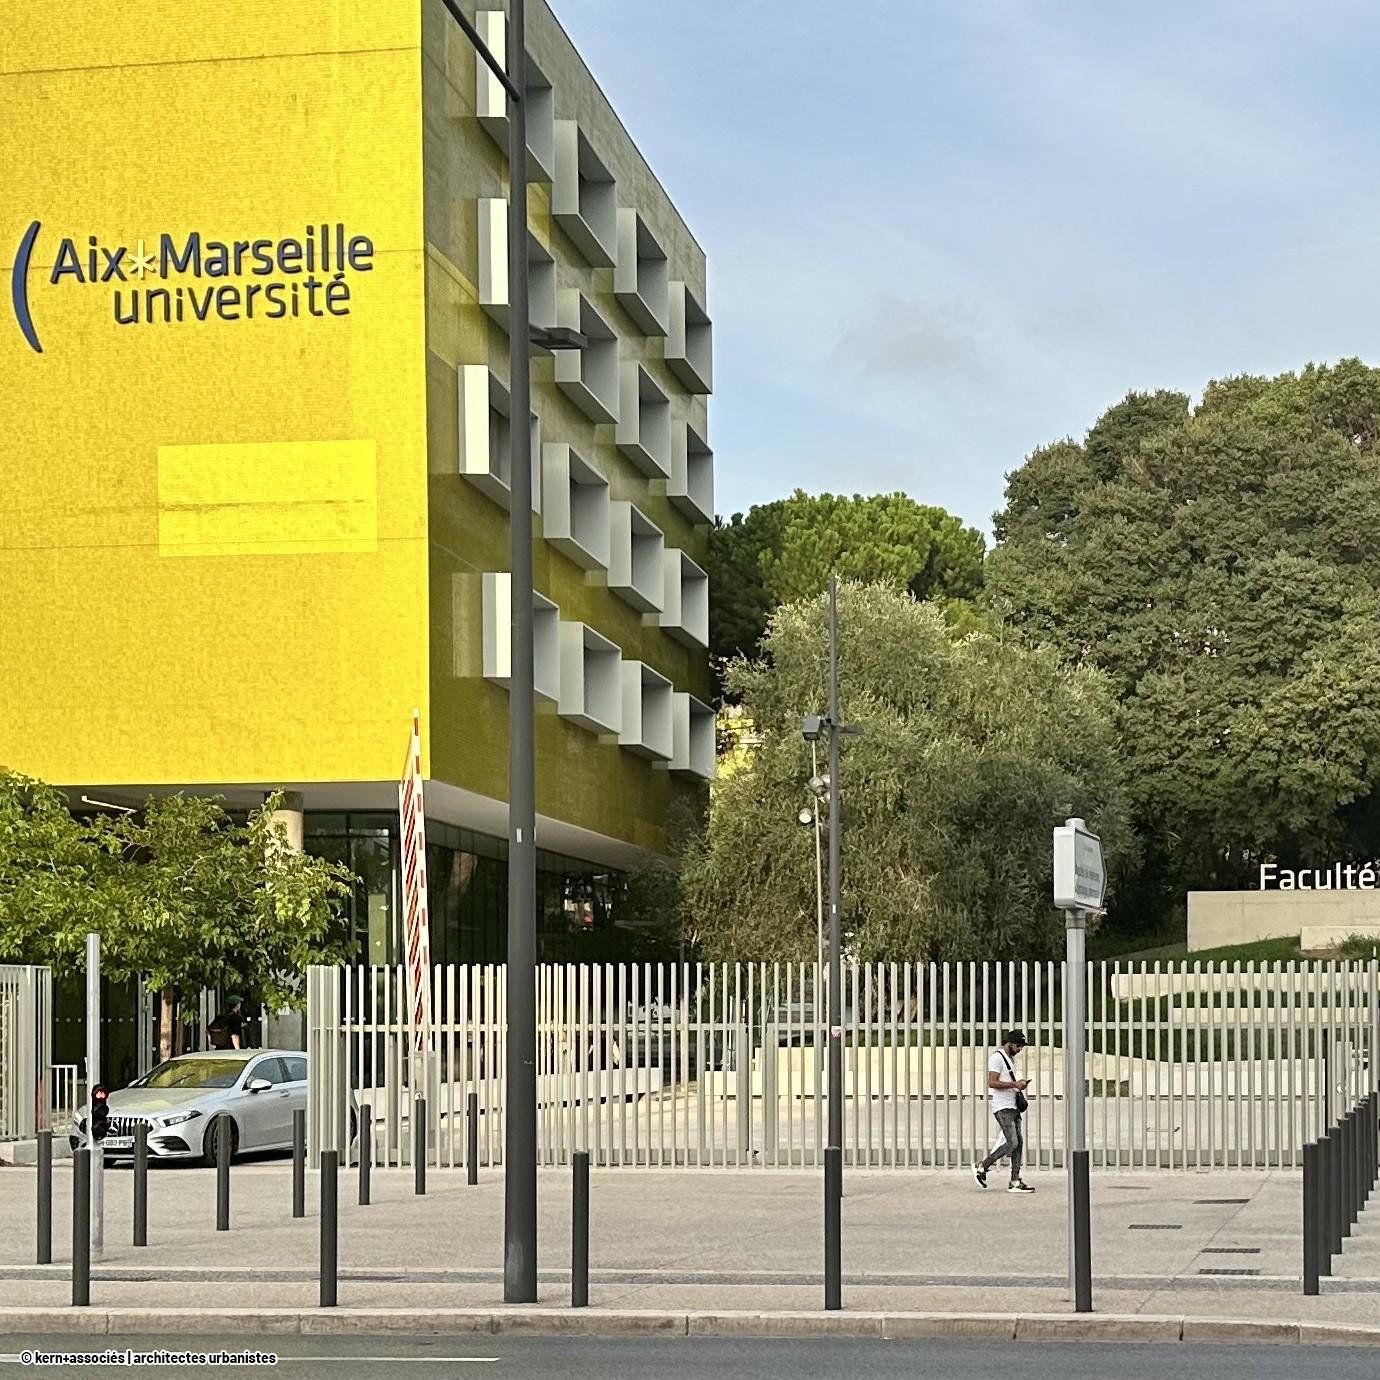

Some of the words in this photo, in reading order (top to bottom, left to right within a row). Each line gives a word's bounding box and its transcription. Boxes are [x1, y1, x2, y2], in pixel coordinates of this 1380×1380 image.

[160, 223, 374, 278] Marseille
[114, 272, 351, 324] université
[1259, 861, 1376, 890] Faculté
